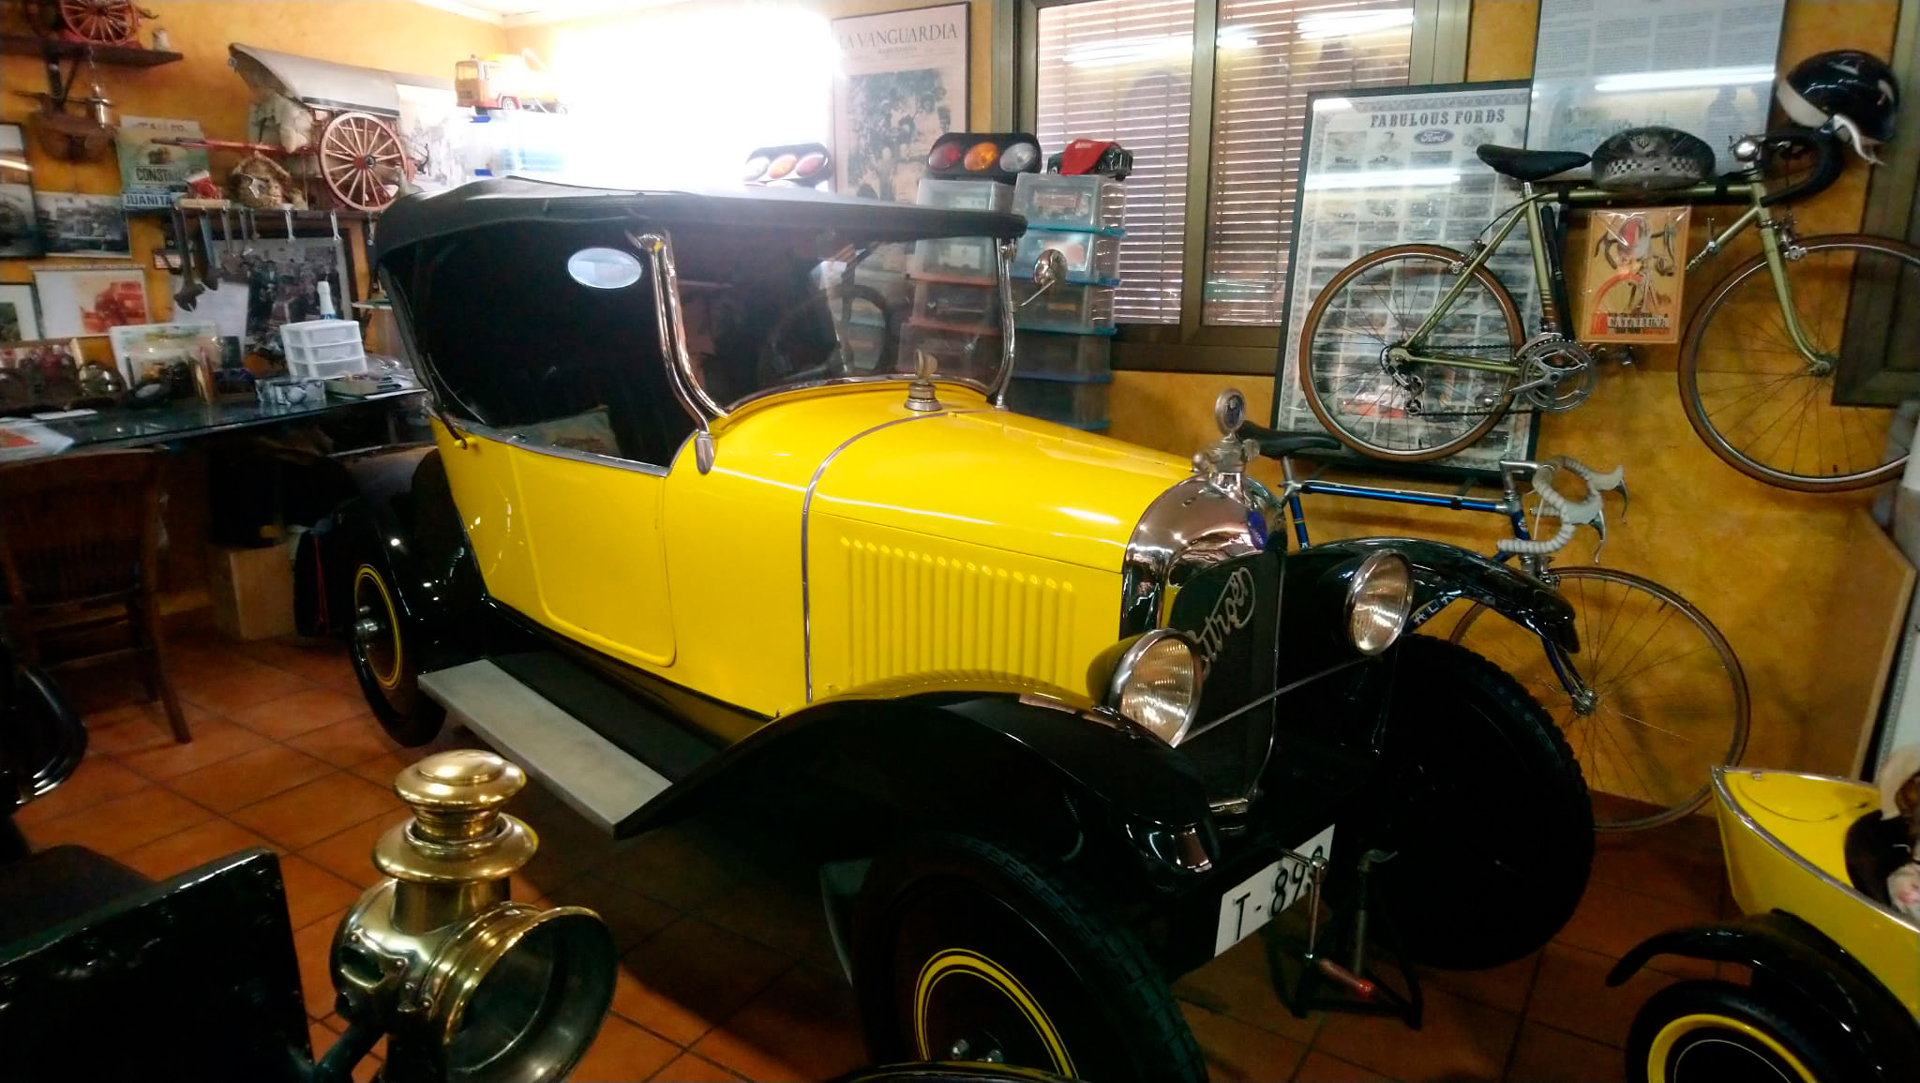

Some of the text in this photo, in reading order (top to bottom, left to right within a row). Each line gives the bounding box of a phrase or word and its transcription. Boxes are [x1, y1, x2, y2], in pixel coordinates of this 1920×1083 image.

[856, 23, 958, 48] VANGUARDIA
[1370, 109, 1506, 128] FABULOUS FORDS
[1420, 131, 1446, 143] Ford
